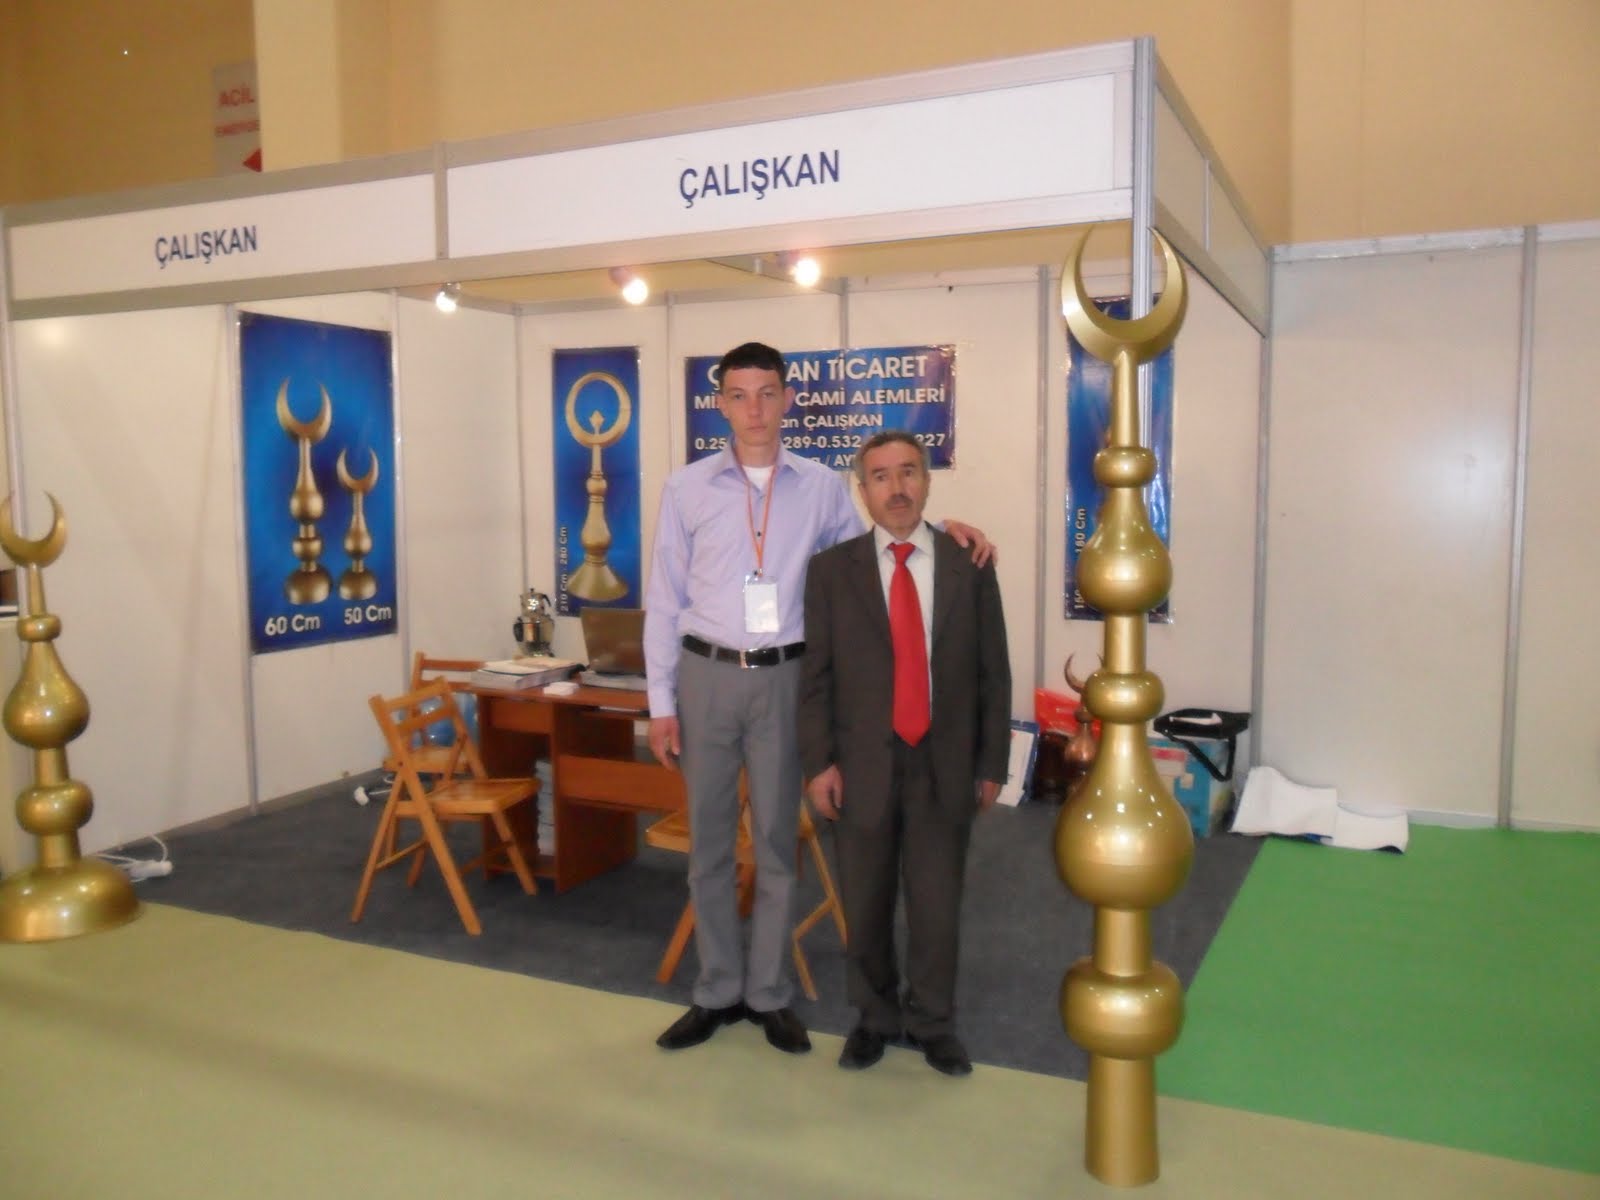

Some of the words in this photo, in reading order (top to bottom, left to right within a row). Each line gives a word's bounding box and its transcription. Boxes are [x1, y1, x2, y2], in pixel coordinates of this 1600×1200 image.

[680, 149, 839, 209] ÇALIŞKAN
[155, 225, 257, 269] ÇALIŞKAN
[827, 354, 928, 380] TİCARET
[795, 387, 845, 406] CAMİ
[851, 384, 945, 405] ALEMLERİ
[803, 413, 882, 431] ÇALIŞKAN
[1074, 508, 1086, 530] Cm
[560, 526, 568, 544] Cm
[264, 616, 287, 636] 60
[291, 614, 320, 632] Cm
[344, 607, 362, 625] 50
[365, 605, 392, 622] Cm
